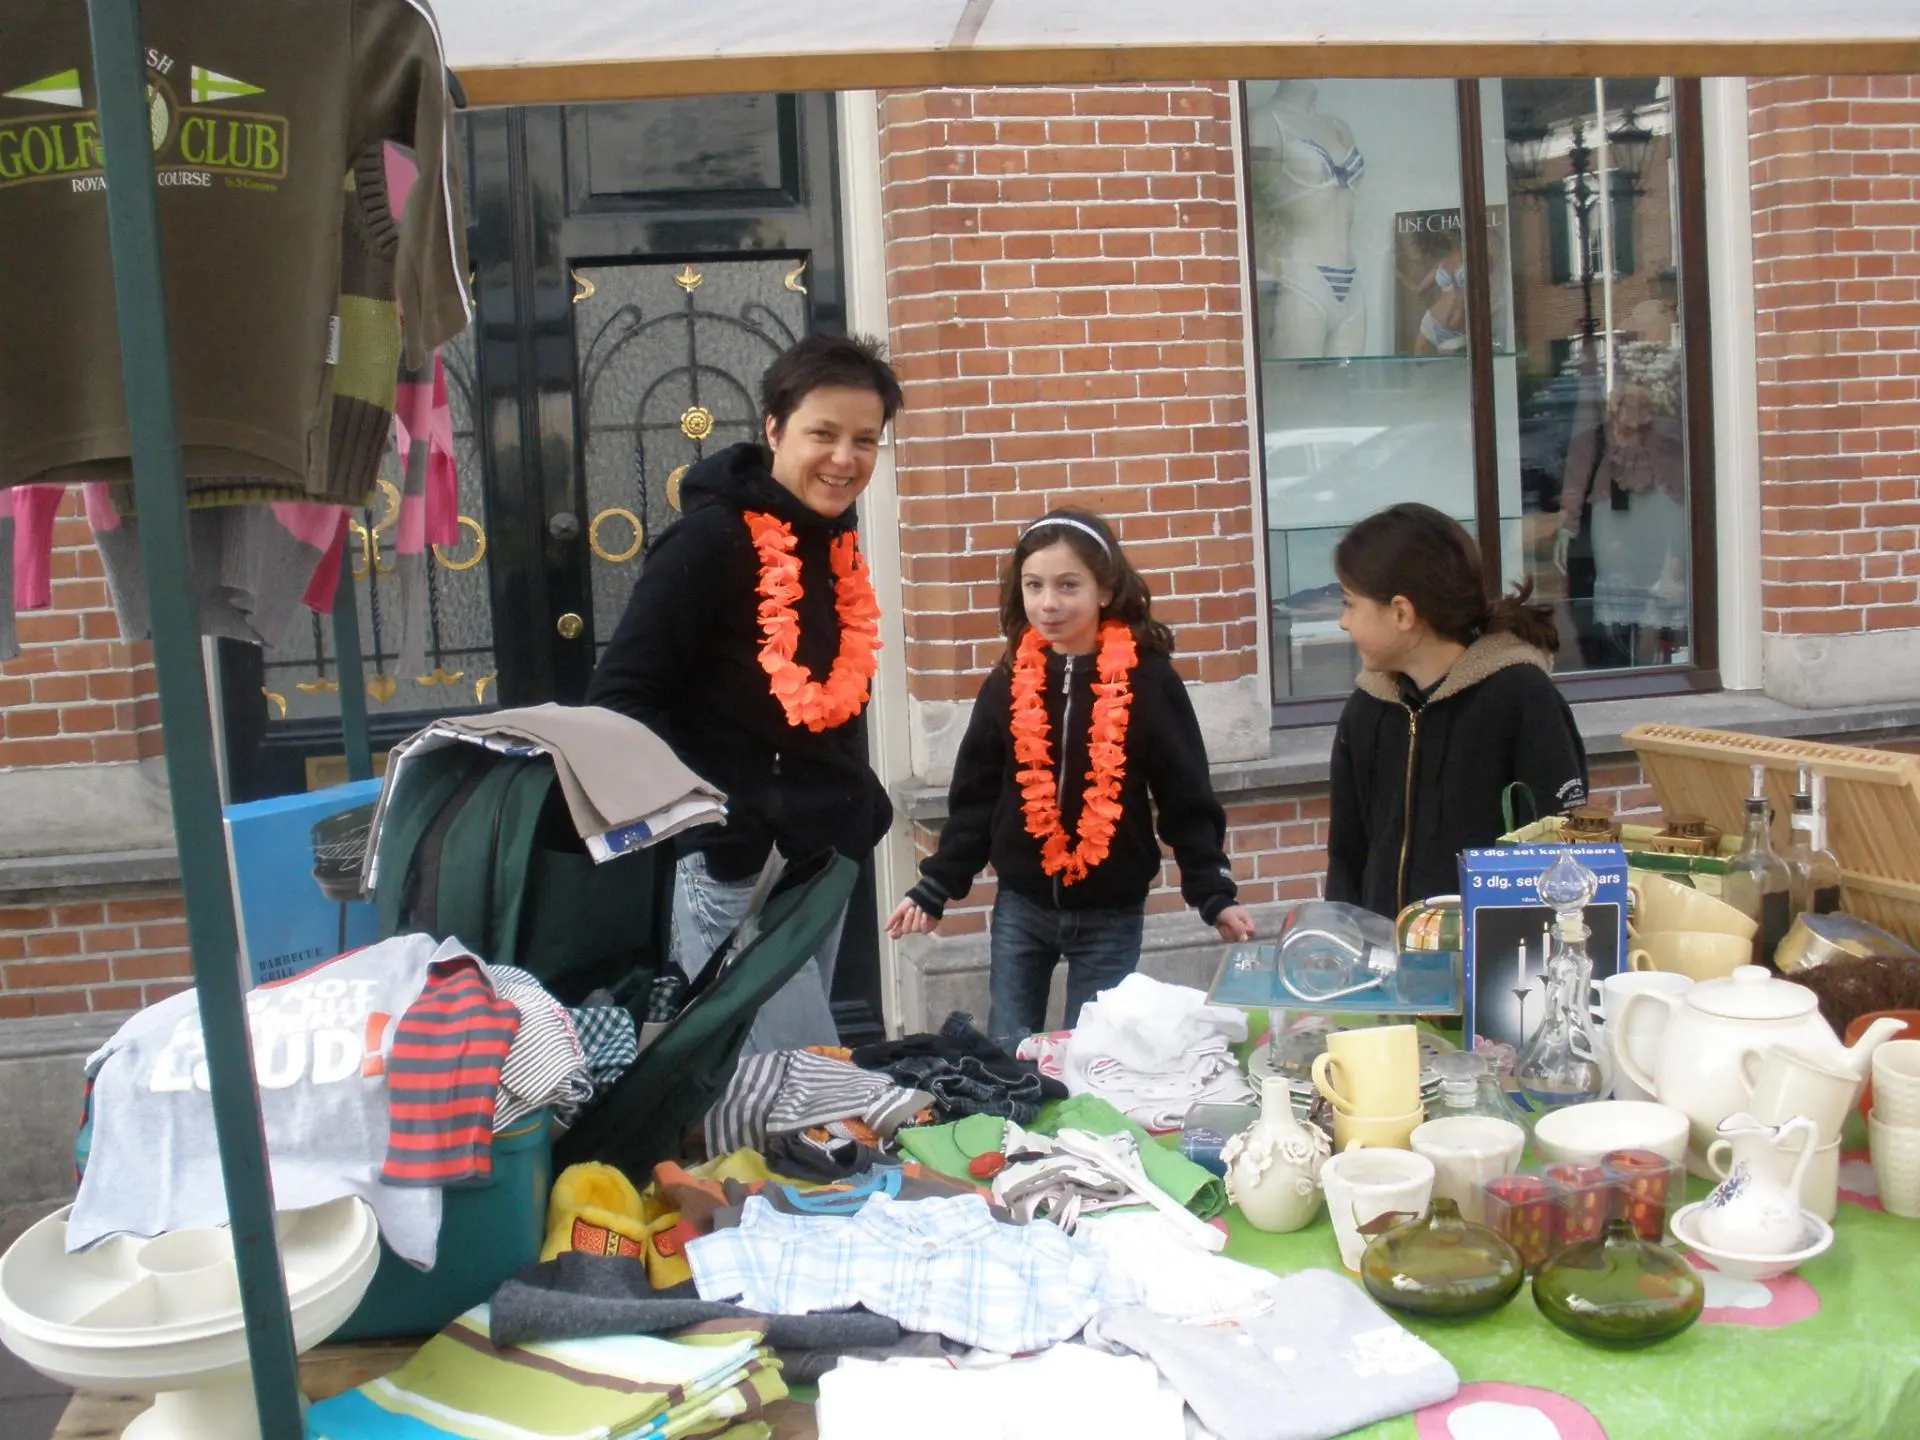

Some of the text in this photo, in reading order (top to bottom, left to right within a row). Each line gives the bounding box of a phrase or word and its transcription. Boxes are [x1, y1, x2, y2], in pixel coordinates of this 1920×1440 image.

[0, 116, 279, 178] GOLF CLUB
[72, 176, 107, 193] ROYA
[158, 171, 211, 187] COURSE
[1398, 216, 1425, 233] LISE
[1470, 849, 1479, 857] 3
[1484, 849, 1508, 857] dlg.
[1473, 875, 1482, 888] 3
[1487, 875, 1512, 889] dlg.
[1516, 875, 1539, 887] set
[258, 946, 325, 971] BARBECUE
[260, 966, 297, 985] GRILL
[281, 977, 381, 1003] NOT
